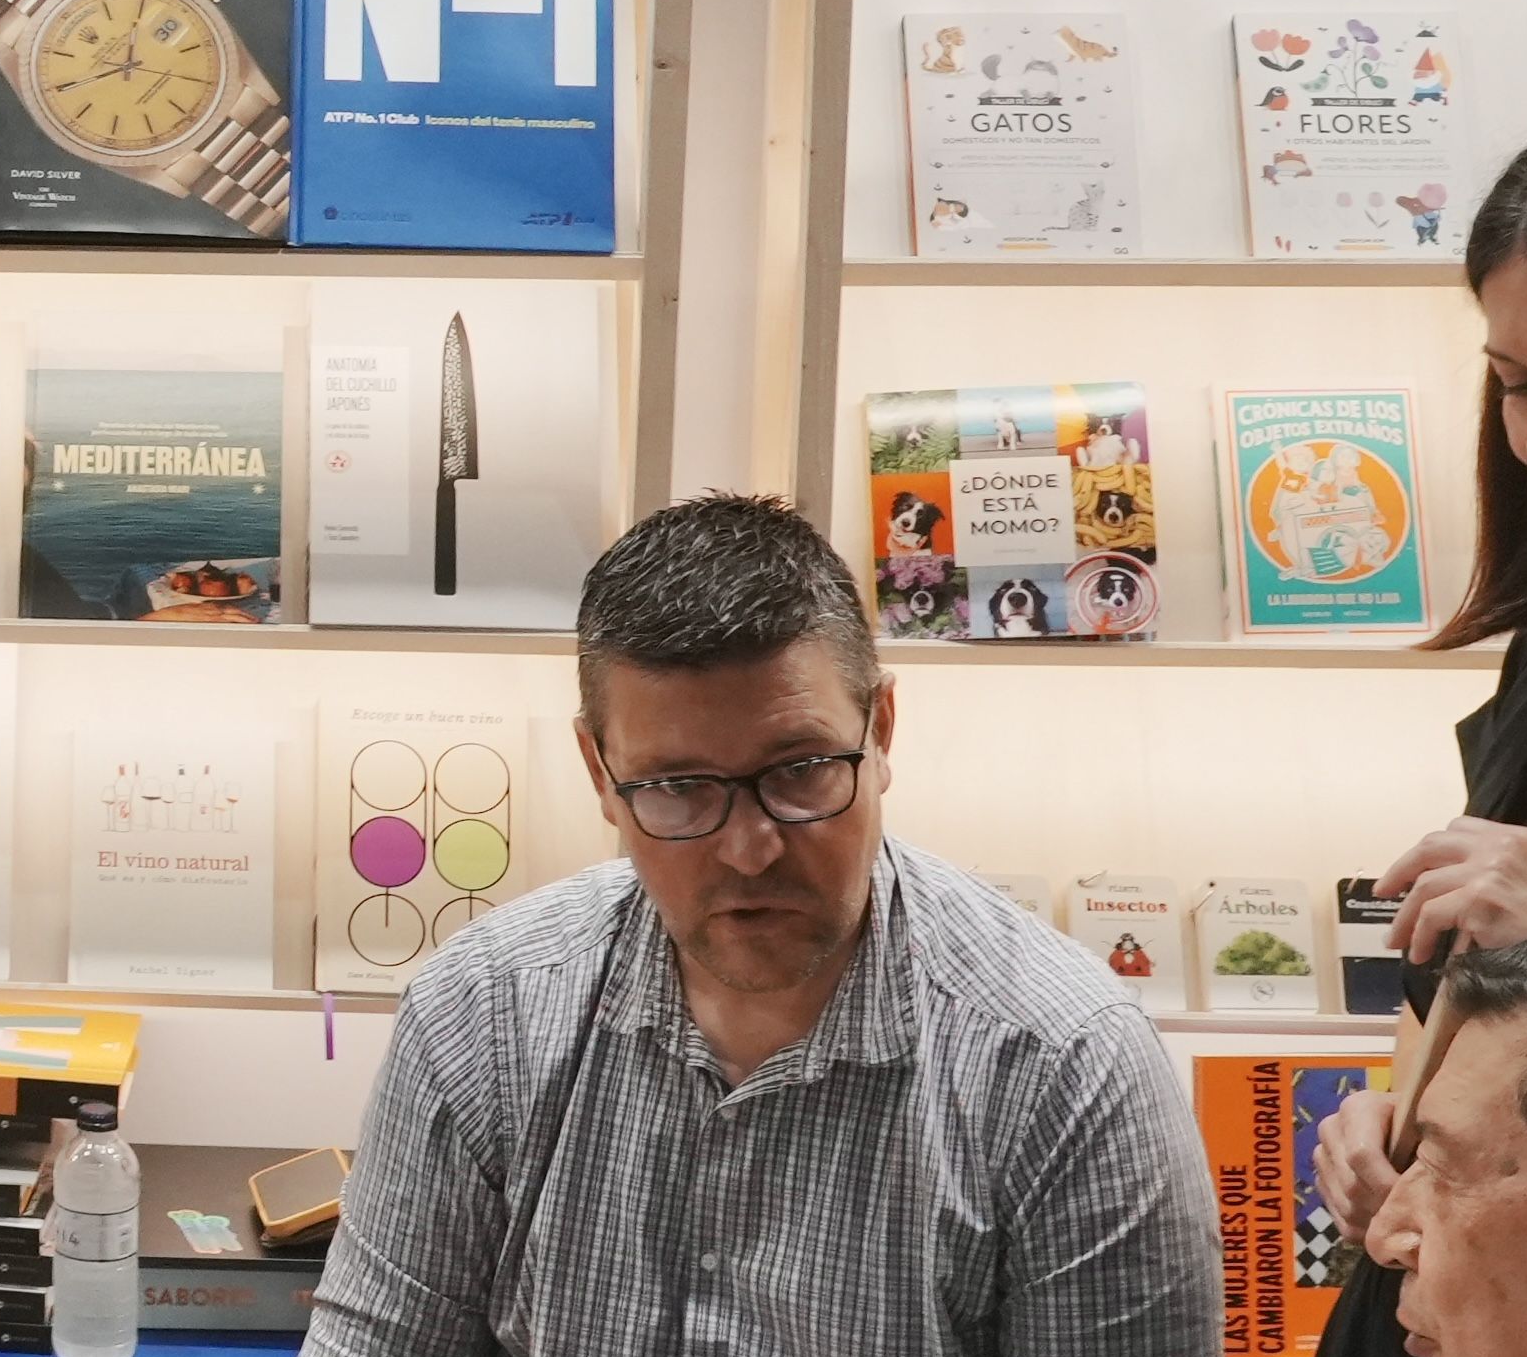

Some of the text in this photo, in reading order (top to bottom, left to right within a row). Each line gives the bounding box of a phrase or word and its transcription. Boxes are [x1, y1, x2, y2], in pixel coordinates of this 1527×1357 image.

[971, 113, 1072, 133] GATOS
[1300, 114, 1412, 135] FLORES
[10, 169, 81, 180] DAVID SILVER
[1336, 400, 1361, 419] DE
[1364, 401, 1400, 423] LOS
[1240, 420, 1307, 448] OBJETOS
[52, 441, 267, 478] MEDITERRÁNEA
[961, 471, 1060, 494] ¿DÓNDE
[982, 492, 1038, 512] ESTÁ
[970, 518, 1060, 535] MOMO?
[97, 851, 250, 872] El vino natural
[1086, 897, 1168, 914] Insectos
[1218, 895, 1298, 916] Árboles
[1246, 1062, 1285, 1354] CAMBIARON LA FOTOGRAFÍA
[1220, 1165, 1252, 1353] LAS MUJERES QUE
